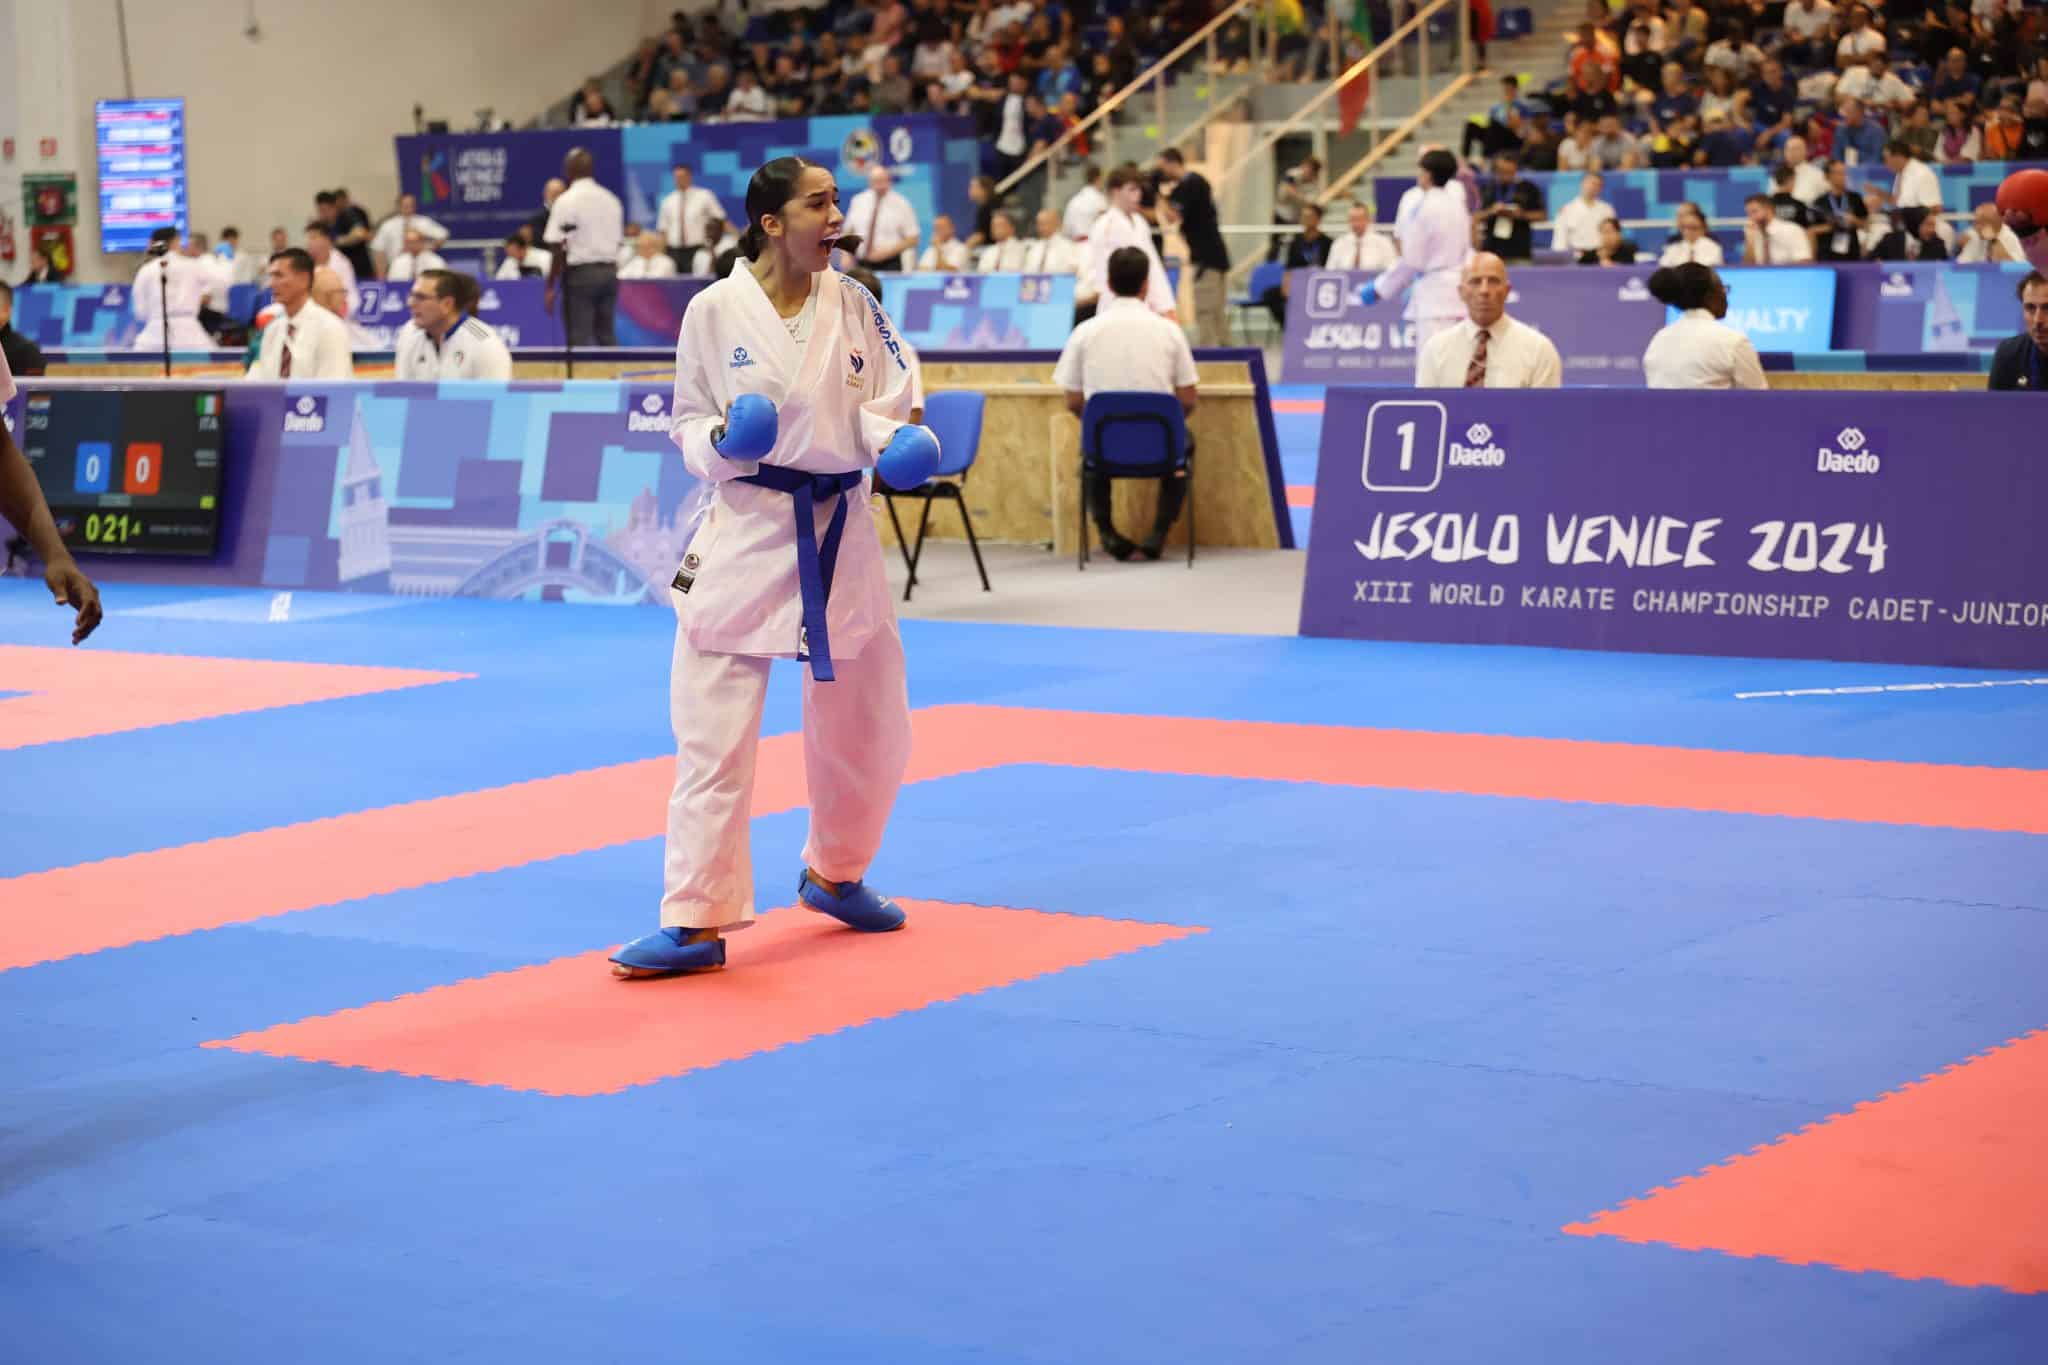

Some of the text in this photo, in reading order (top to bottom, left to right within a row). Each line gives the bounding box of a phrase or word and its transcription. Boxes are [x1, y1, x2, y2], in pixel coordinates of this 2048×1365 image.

[1318, 281, 1338, 309] 6
[1727, 307, 1809, 332] NALTY
[1397, 421, 1415, 471] 1
[1449, 443, 1505, 466] Daedo
[1817, 448, 1880, 473] Daedo
[85, 454, 150, 484] 0 0
[1354, 511, 1888, 574] JESOLO VENICE 2024
[1353, 580, 1413, 604] XIII
[1428, 583, 1505, 607] WORLD
[1520, 586, 1615, 612] KARATE
[1632, 588, 1830, 619] CHAMPIONSHIP
